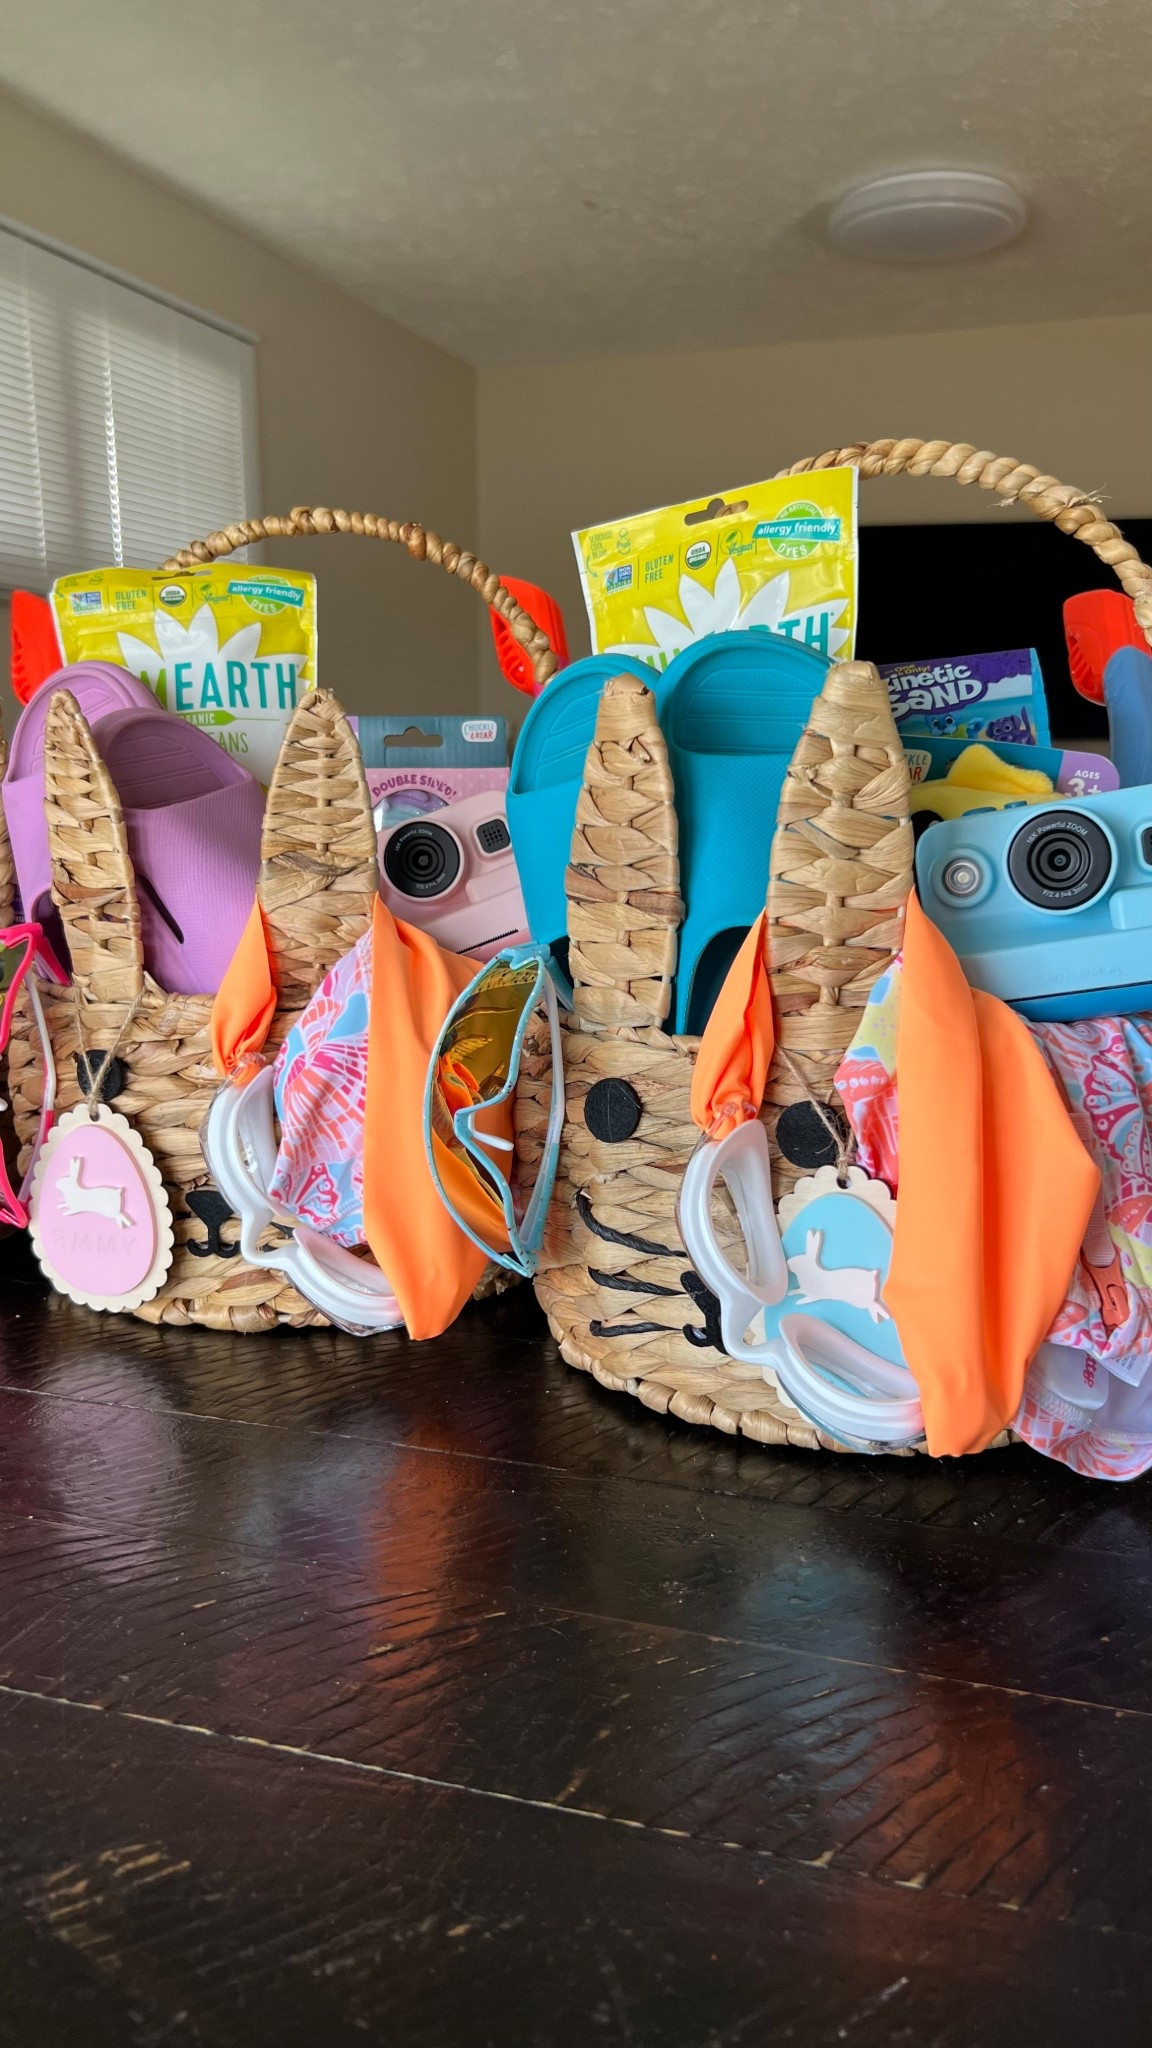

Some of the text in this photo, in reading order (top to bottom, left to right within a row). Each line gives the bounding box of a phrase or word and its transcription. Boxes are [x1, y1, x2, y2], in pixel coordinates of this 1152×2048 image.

[758, 522, 837, 536] allergy friendly
[777, 543, 808, 558] DYES
[645, 554, 674, 572] GLUTEN
[645, 568, 664, 584] FREE
[115, 589, 147, 600] GLUTEN
[231, 584, 302, 601] allergy friendly
[116, 601, 137, 611] FREE
[250, 599, 277, 613] DYES
[140, 661, 297, 711] MEARTH
[182, 713, 216, 725] GANIC
[464, 723, 495, 735] CHUCKLE
[475, 731, 493, 740] ROAR
[209, 731, 249, 753] ANS
[1075, 769, 1100, 780] AGES
[372, 774, 417, 798] DOUBLE
[1064, 778, 1102, 797] 3+
[1037, 821, 1066, 834] Powerful
[1066, 822, 1089, 836] ZOOM
